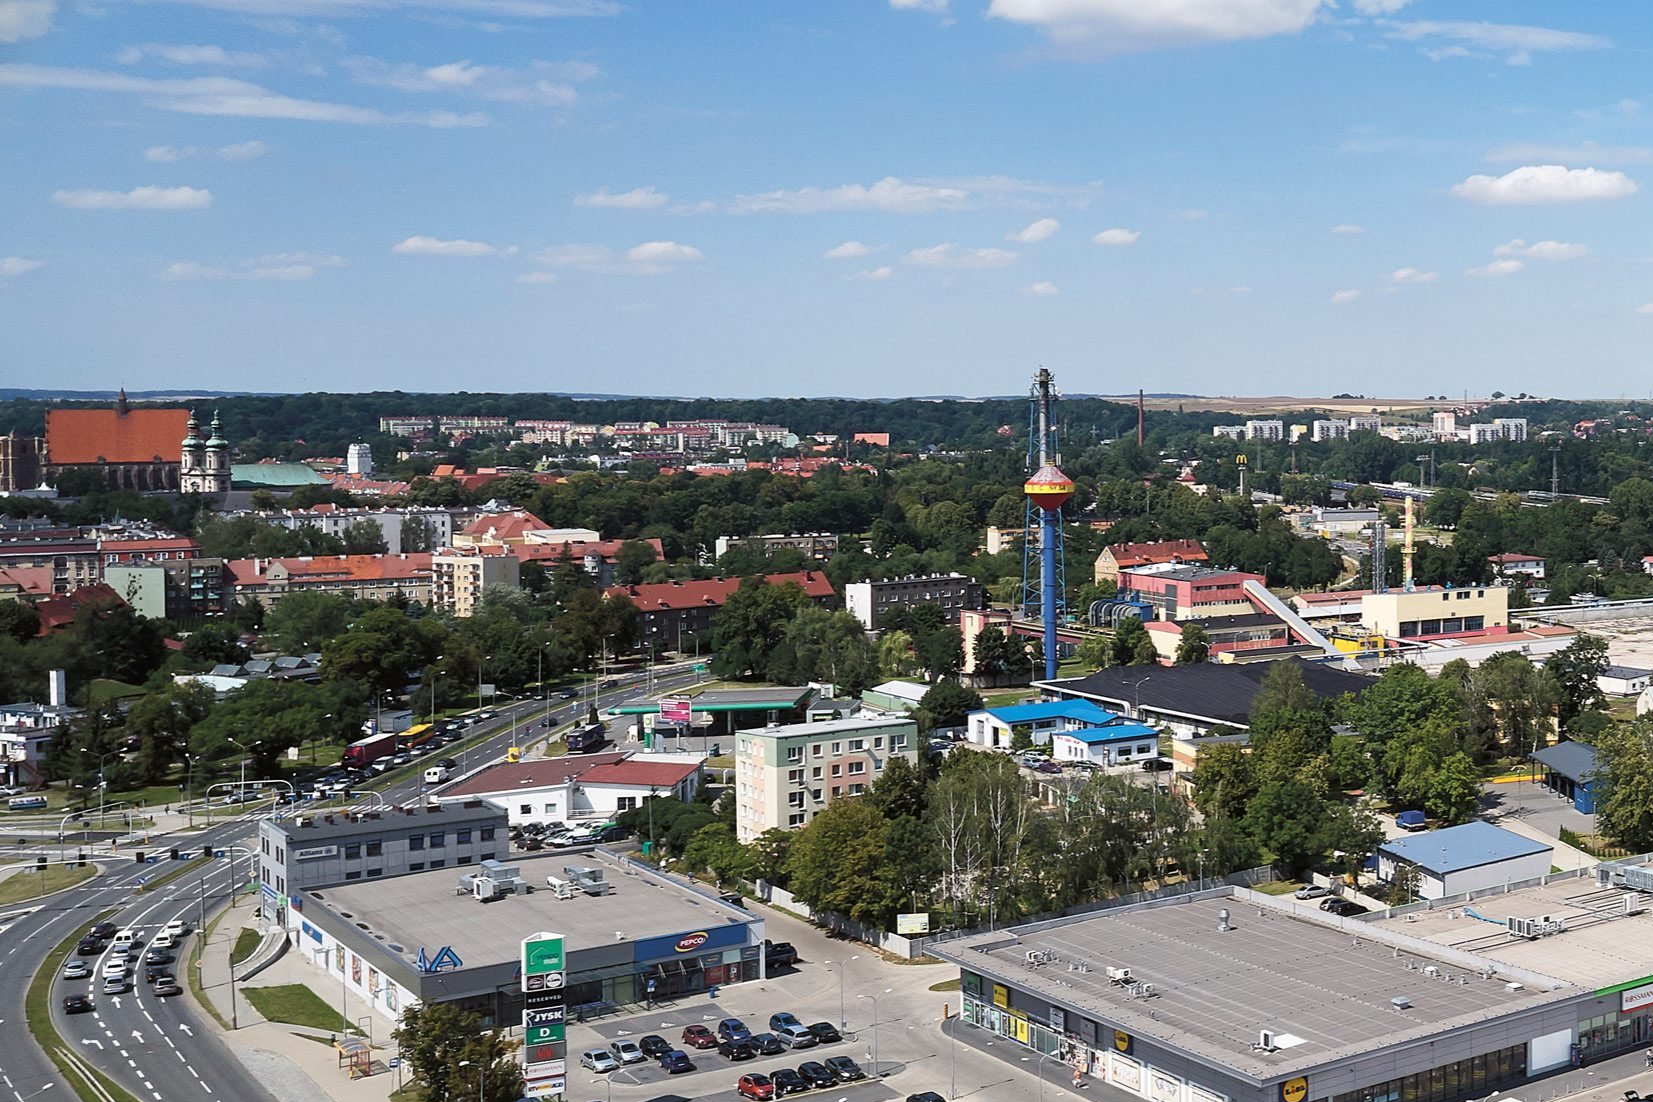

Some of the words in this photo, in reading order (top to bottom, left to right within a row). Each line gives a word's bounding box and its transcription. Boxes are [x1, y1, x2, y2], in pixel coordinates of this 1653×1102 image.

[680, 937, 705, 948] PEPCO
[528, 995, 562, 1003] RESERVED
[534, 1011, 563, 1022] JYSK
[540, 1027, 550, 1037] D
